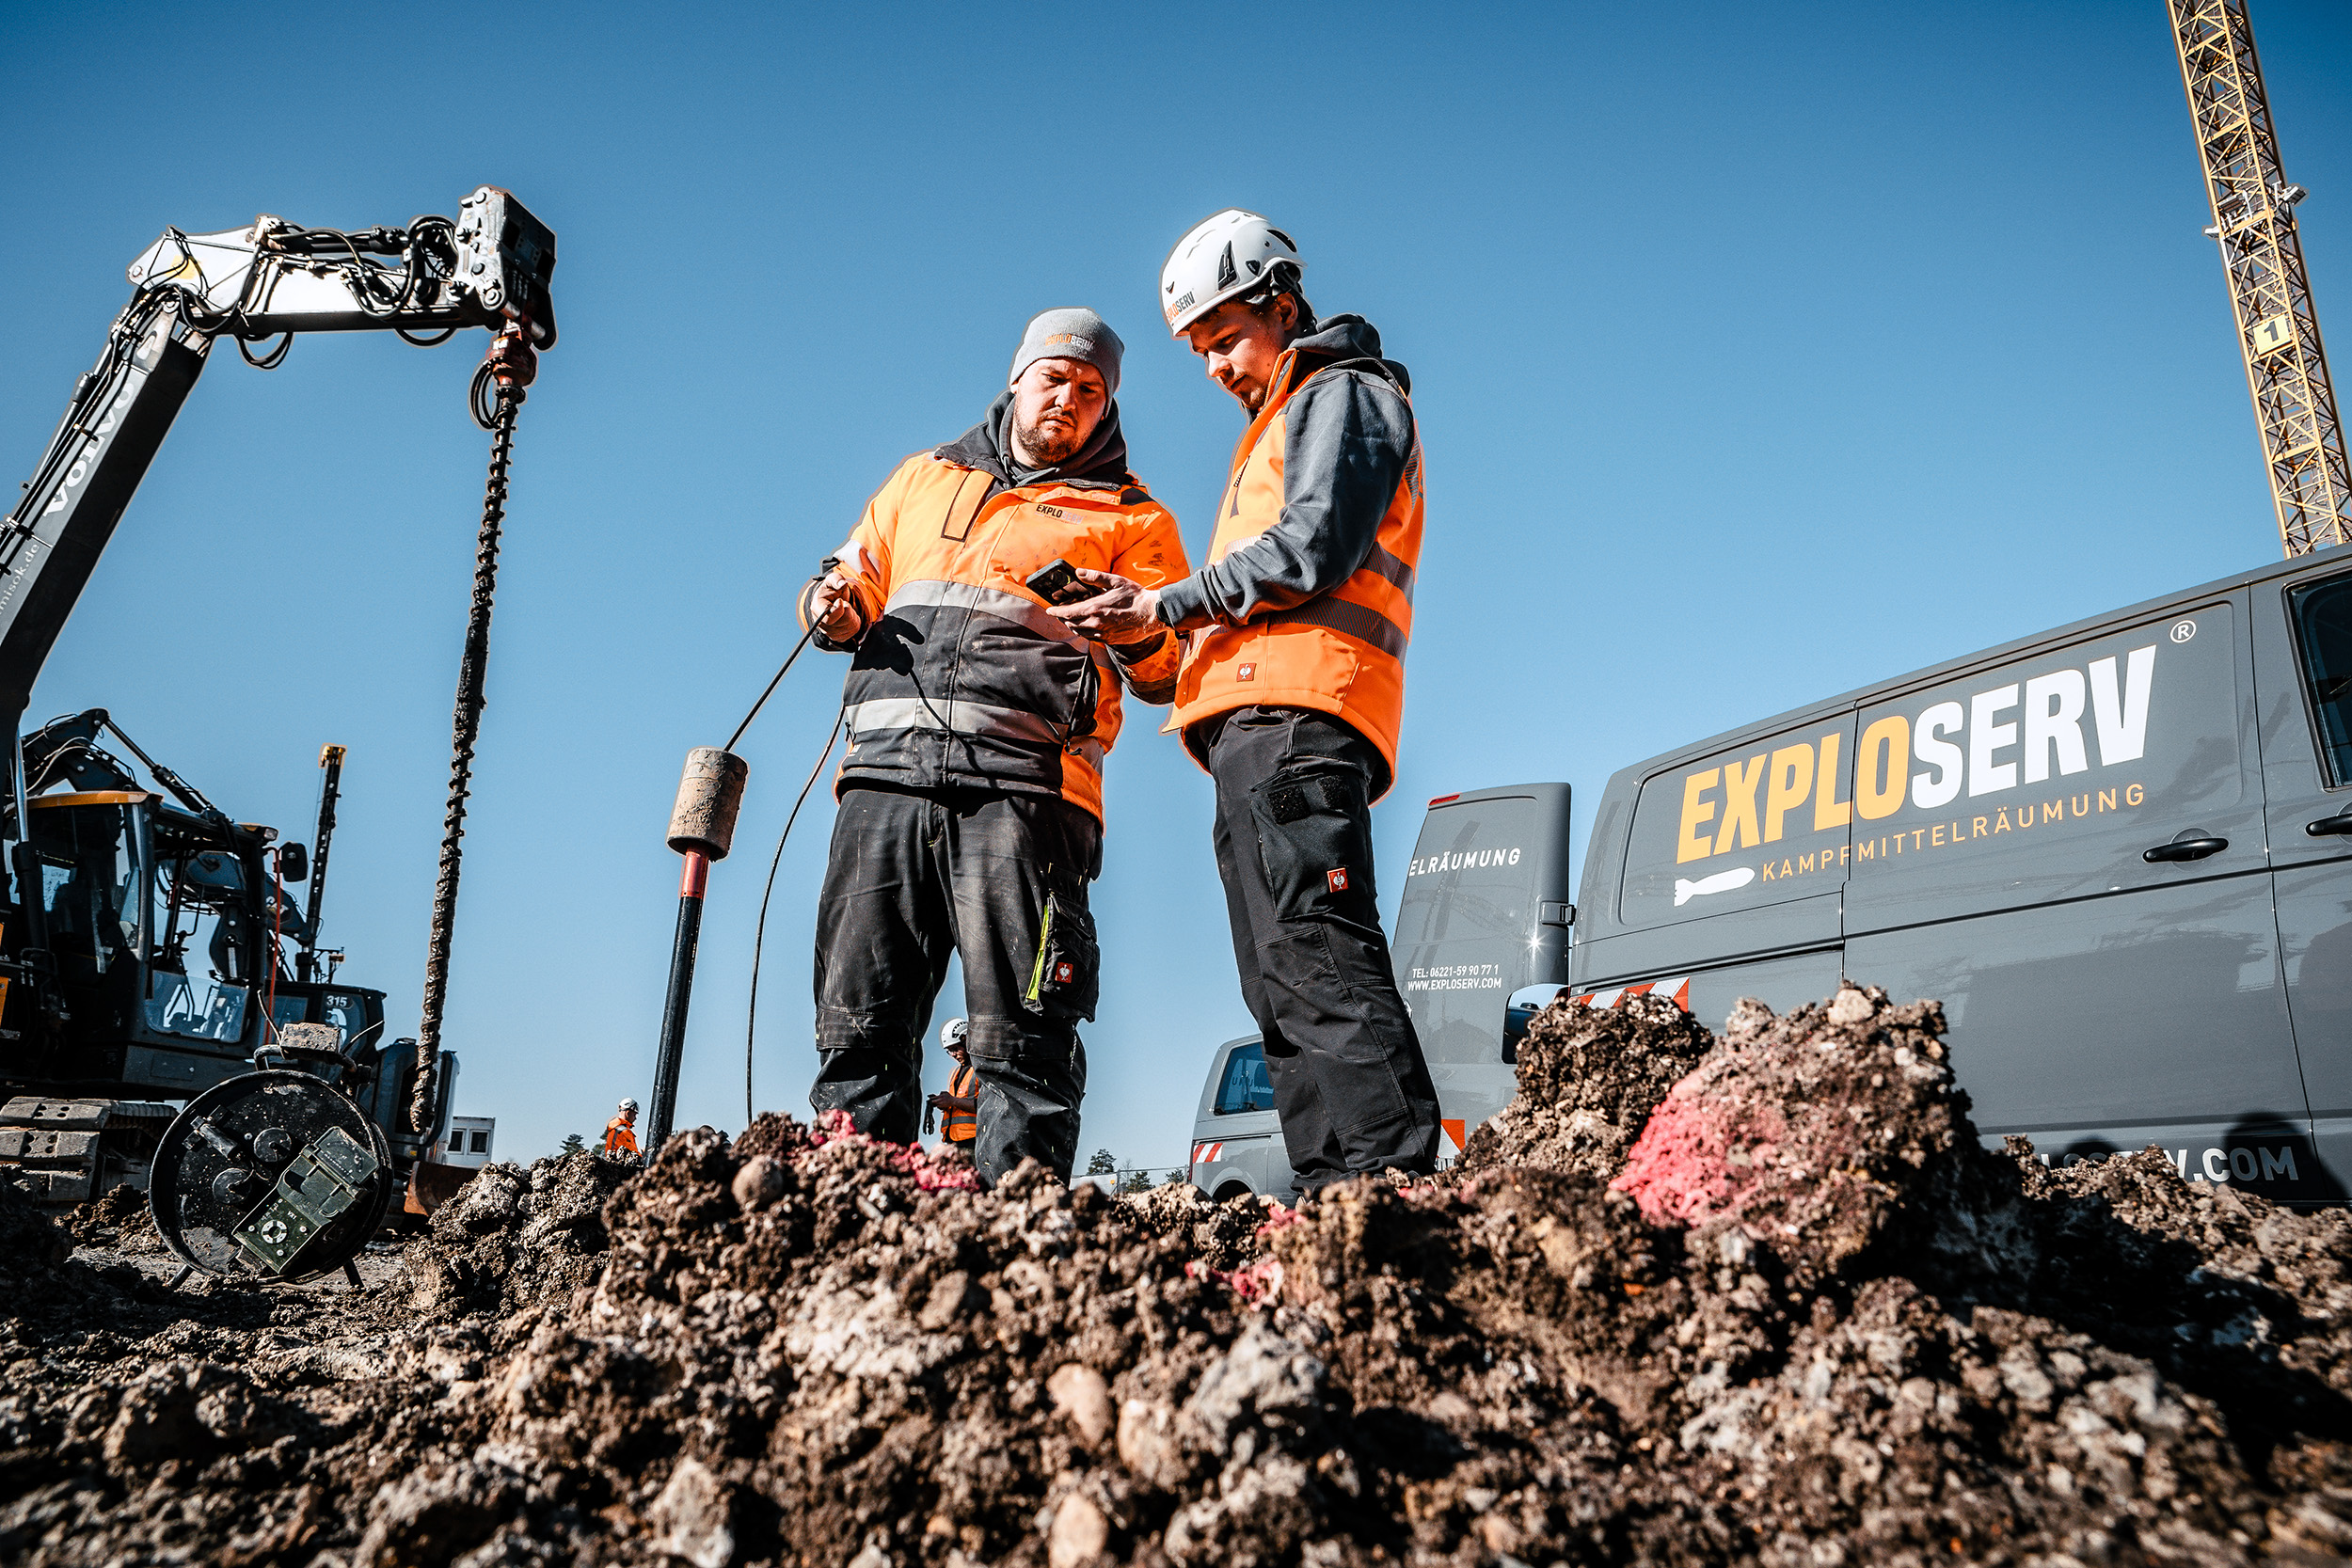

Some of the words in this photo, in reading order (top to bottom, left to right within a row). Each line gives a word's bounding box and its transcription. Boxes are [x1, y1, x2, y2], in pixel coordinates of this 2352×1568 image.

[2264, 321, 2279, 342] 1
[1036, 504, 1084, 524] EXPLOSERV
[1677, 644, 2157, 863] EXPLOSERV
[1762, 783, 2145, 882] KAMPFMITTELRÄUMUNG
[1408, 847, 1521, 877] ELRÄUMUNG
[1412, 968, 1429, 978] TEL:
[1430, 966, 1467, 977] 06221-59
[1469, 965, 1479, 975] 90
[1481, 964, 1492, 975] 77
[1494, 964, 1499, 974] 1
[1407, 977, 1502, 990] WWW.EXPLOSERV.COM
[326, 995, 347, 1007] 315
